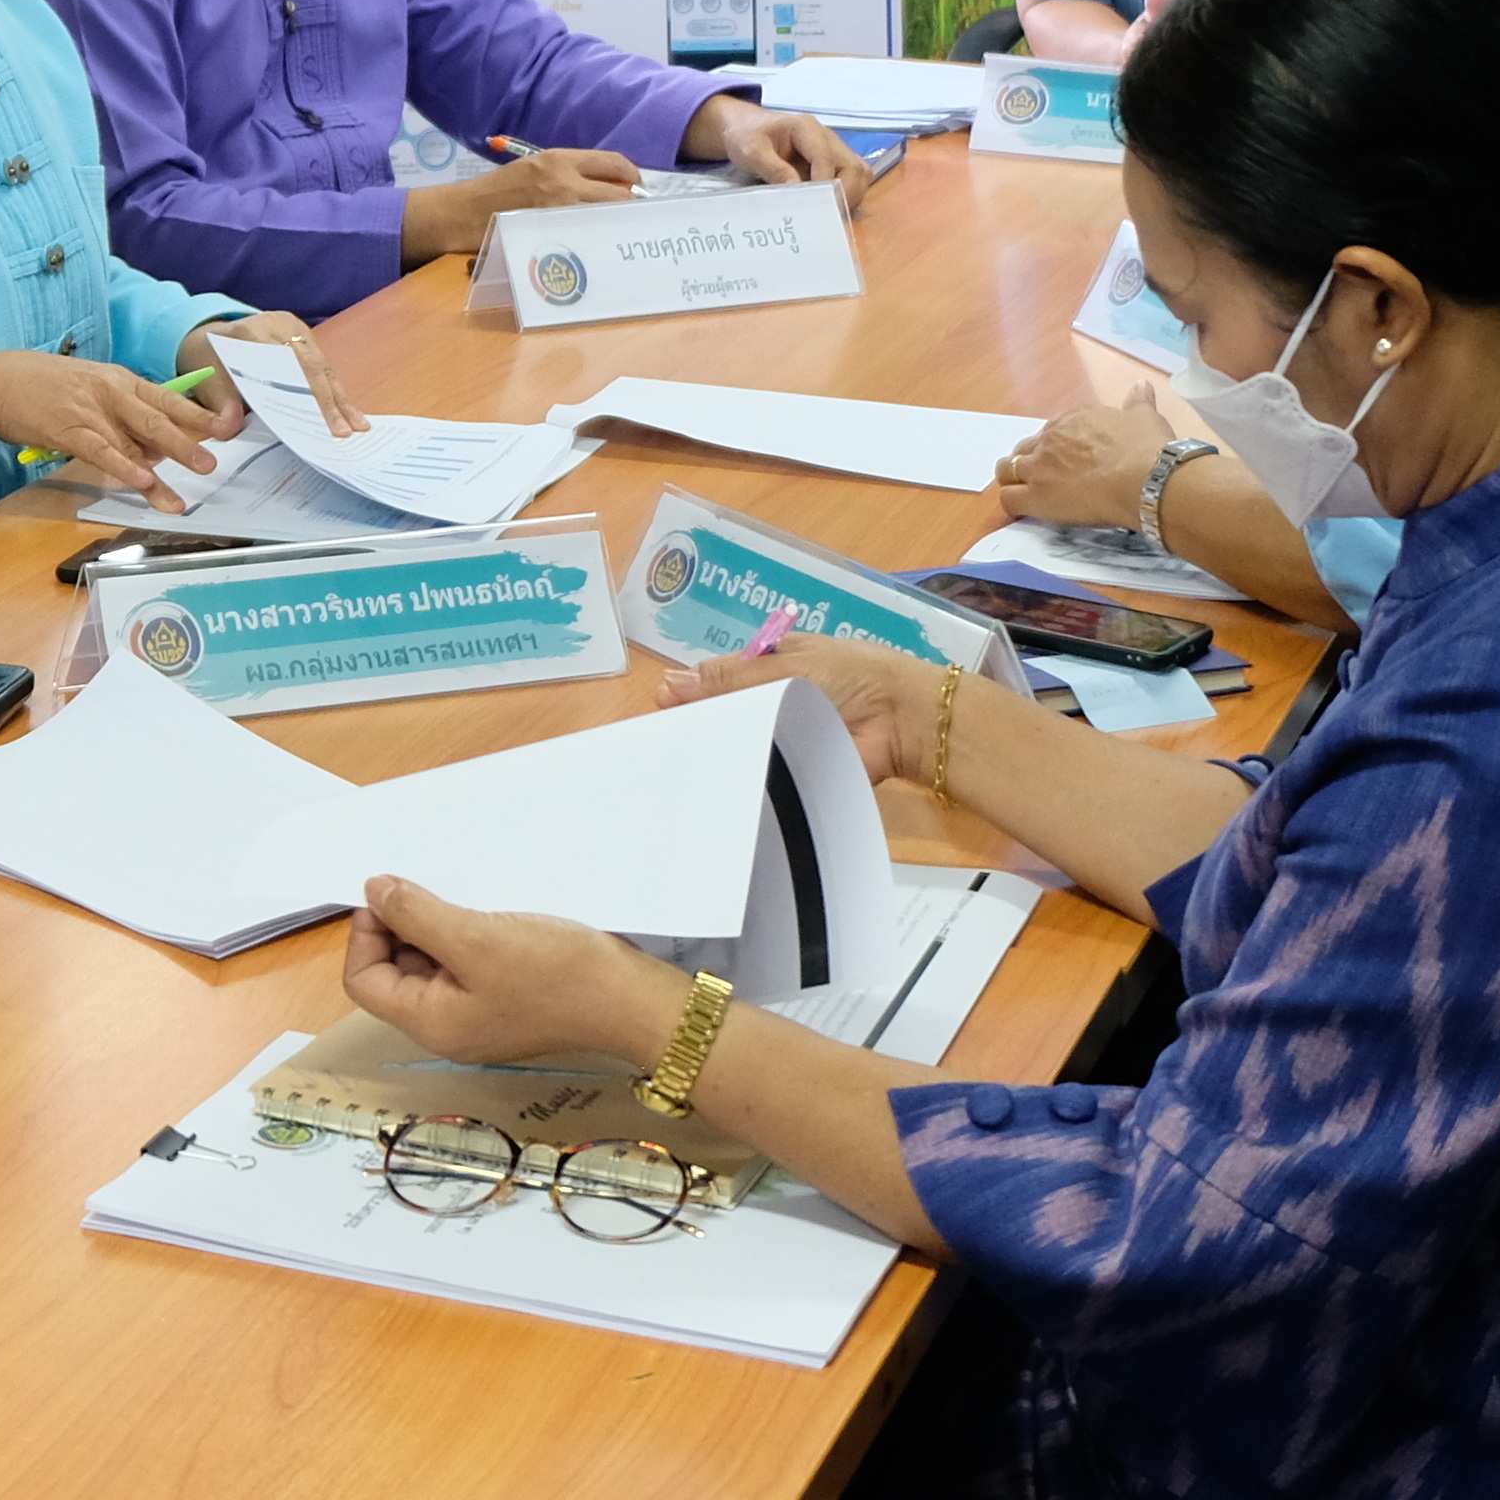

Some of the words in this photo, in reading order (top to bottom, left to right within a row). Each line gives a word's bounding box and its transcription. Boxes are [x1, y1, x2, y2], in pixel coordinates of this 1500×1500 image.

[616, 222, 735, 266] นายศุภกิตต์
[742, 216, 800, 254] รอบรู้
[680, 275, 758, 302] ผู้ช่วยผู้ตรวจ
[203, 593, 403, 635] นางสาววรินทร
[244, 631, 539, 683] ผอ.กลุ่มงานสารสนเทศฯ
